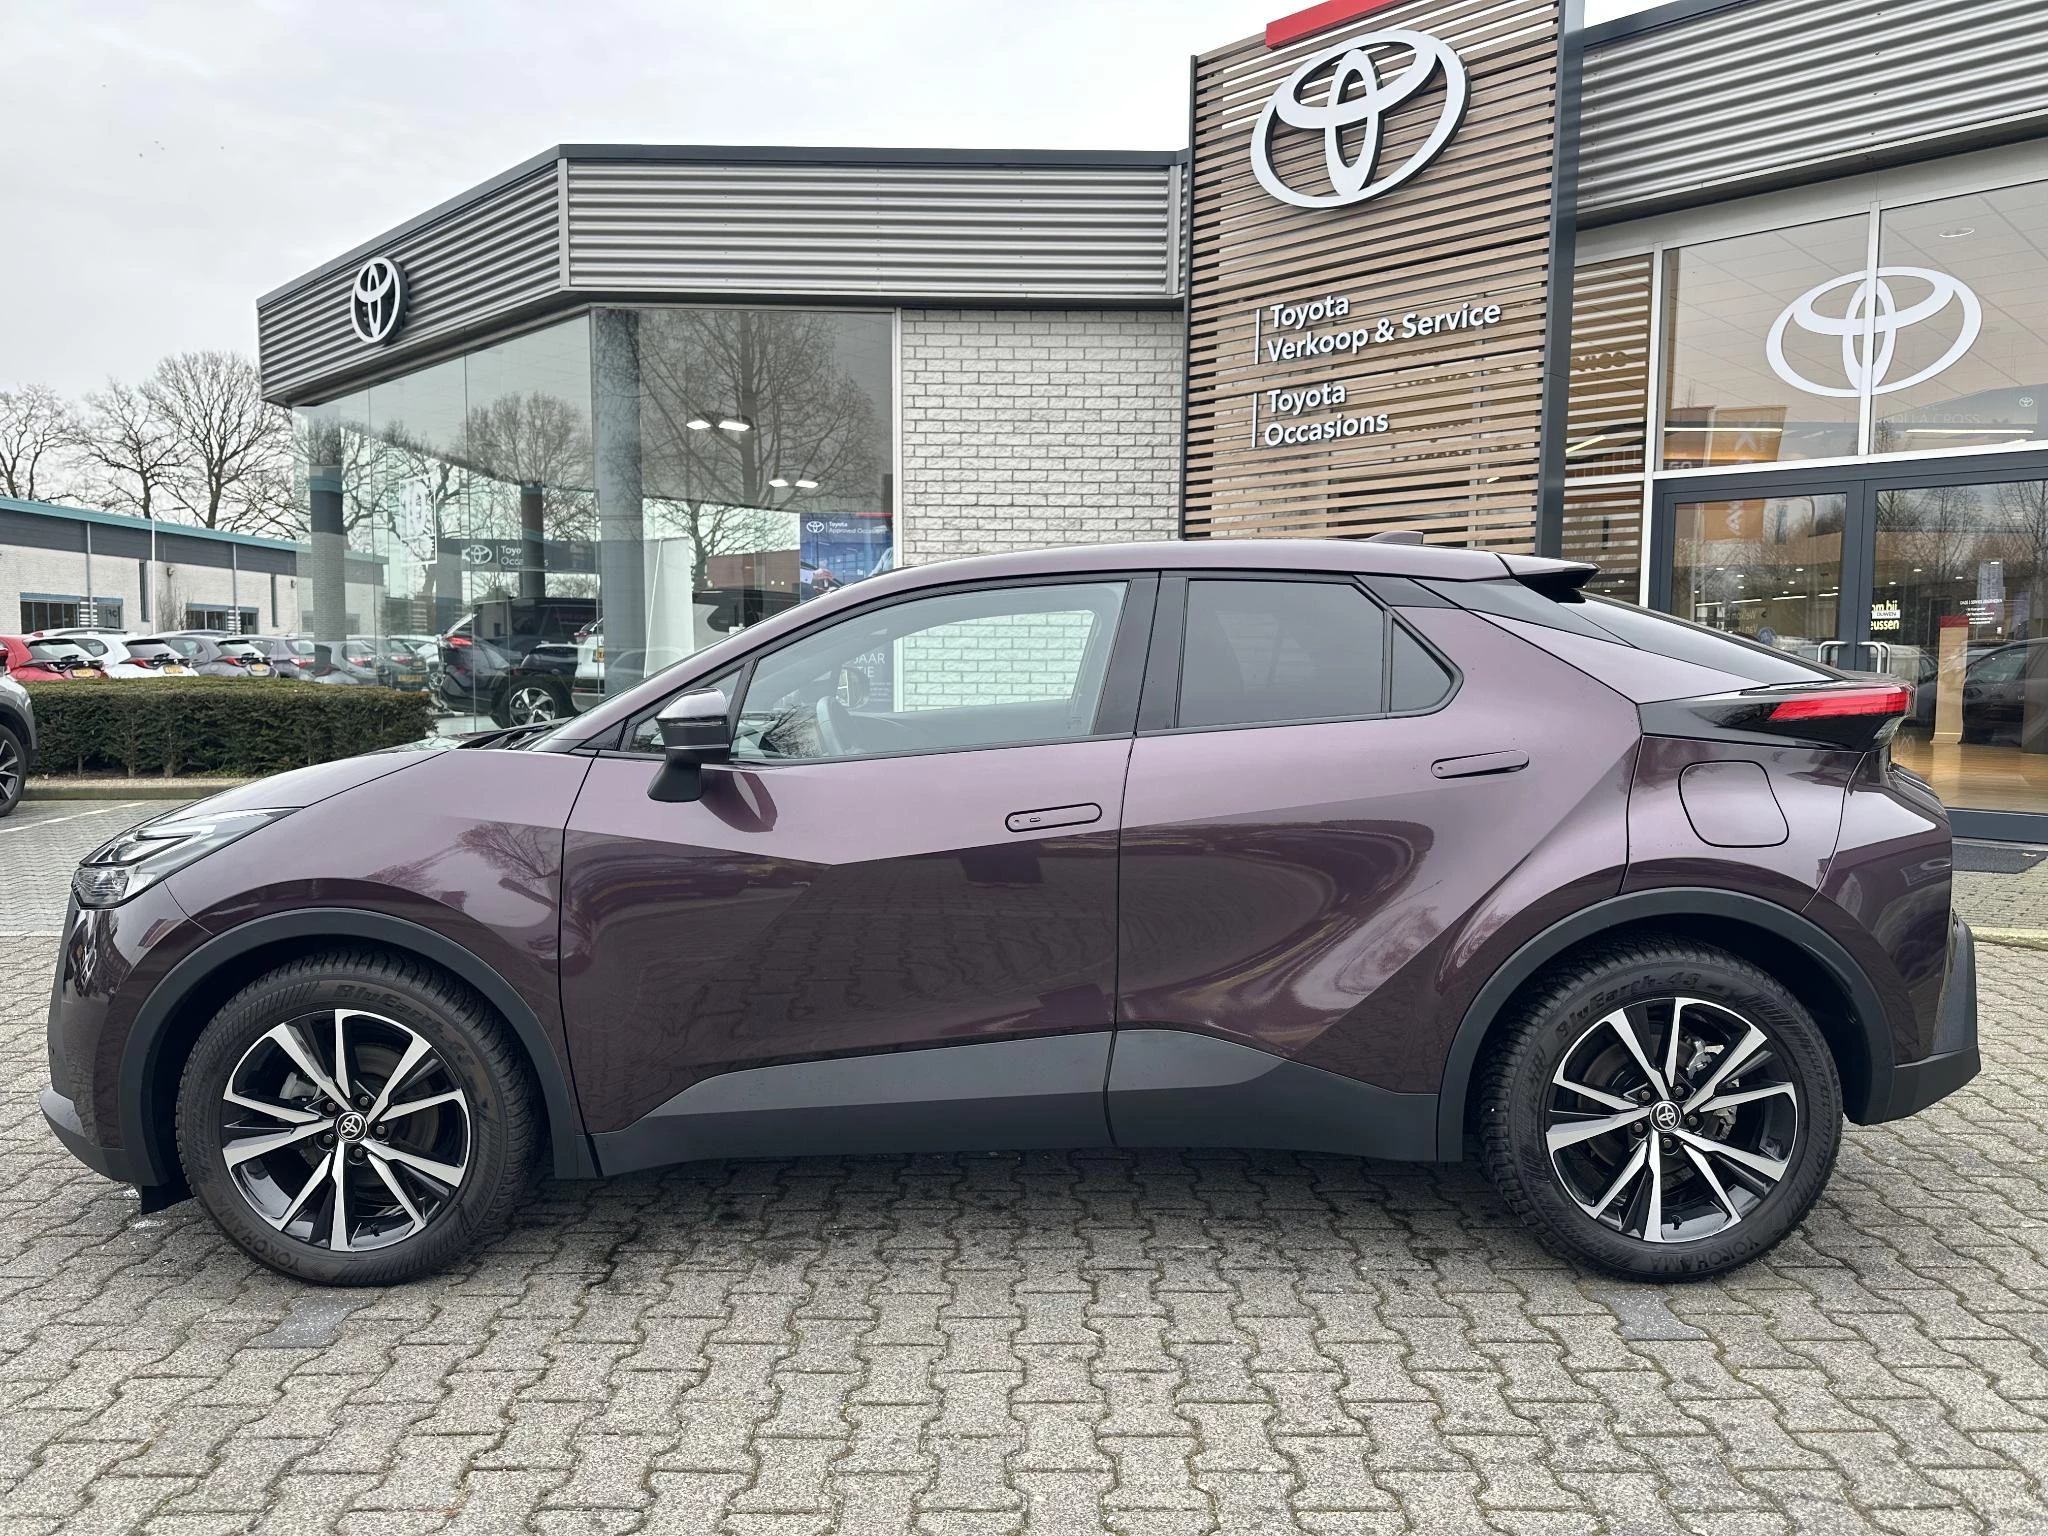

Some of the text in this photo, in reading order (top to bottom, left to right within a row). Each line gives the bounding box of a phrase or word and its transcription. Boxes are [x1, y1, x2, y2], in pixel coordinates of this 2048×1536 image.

[1270, 295, 1349, 330] Toyota
[1267, 302, 1501, 362] Verkoop & Service
[1267, 382, 1346, 416] Toyota
[1264, 412, 1389, 446] Occasions
[1649, 1235, 1761, 1272] YOKOHAMA
